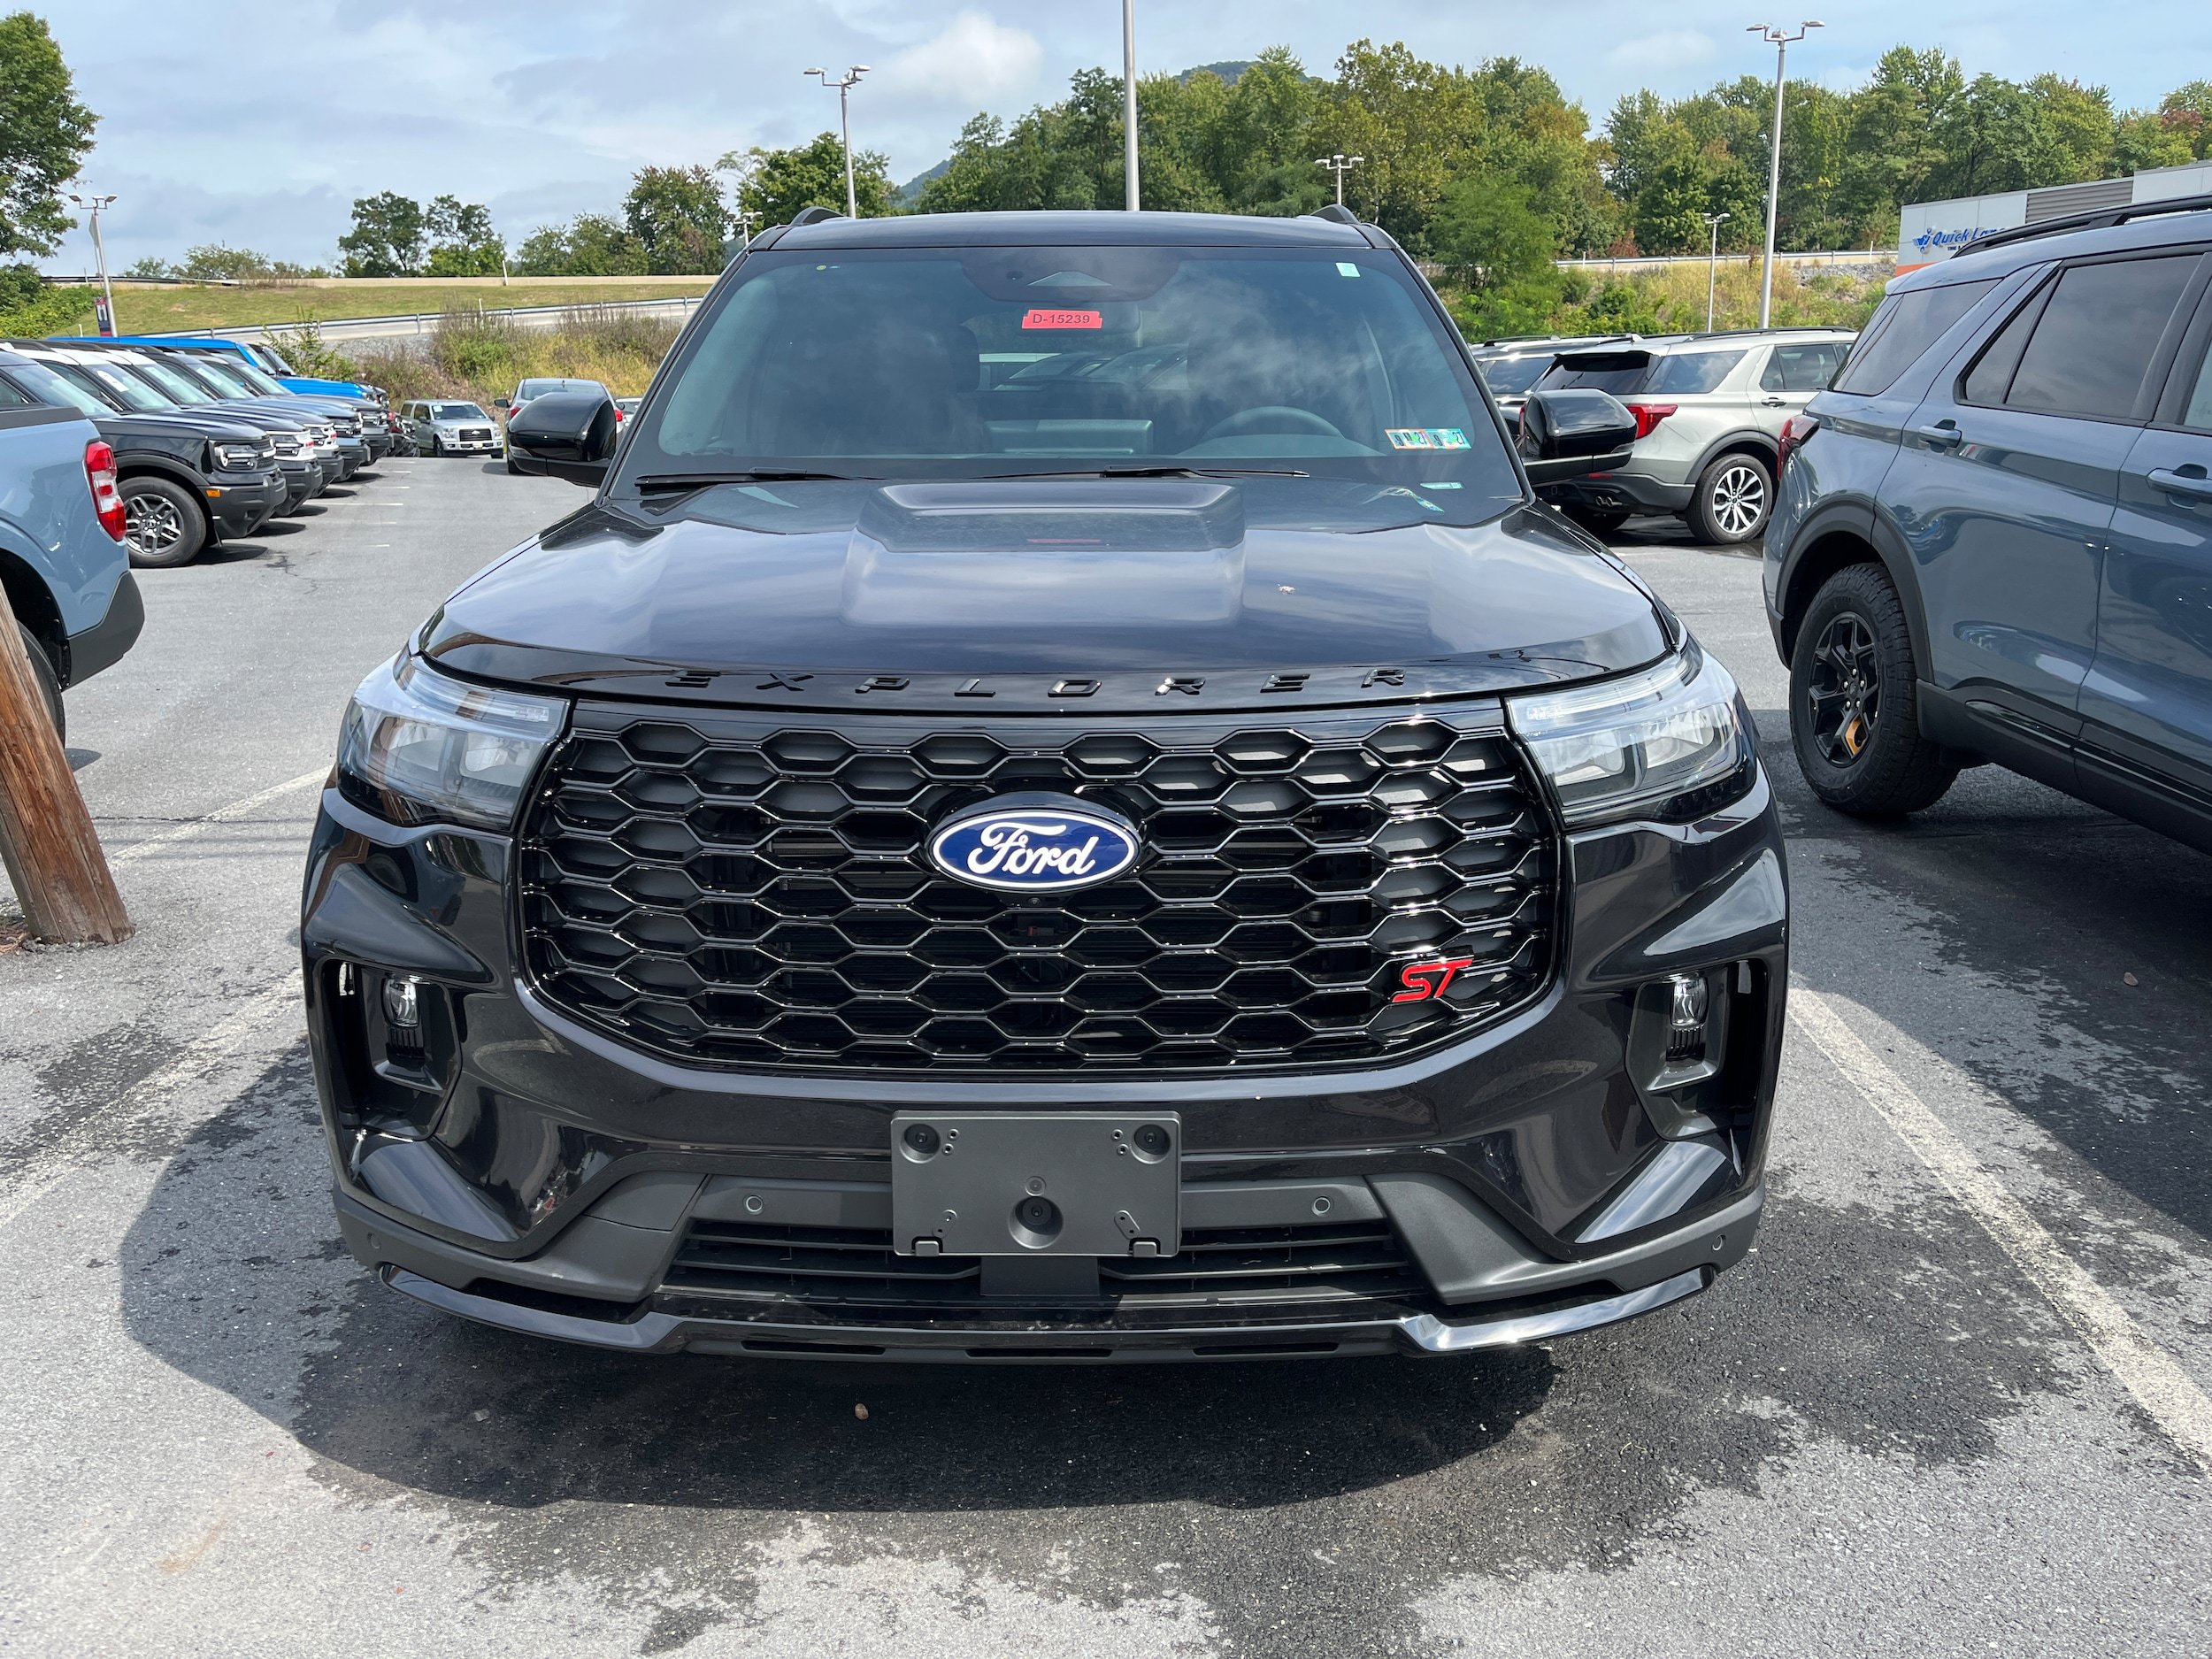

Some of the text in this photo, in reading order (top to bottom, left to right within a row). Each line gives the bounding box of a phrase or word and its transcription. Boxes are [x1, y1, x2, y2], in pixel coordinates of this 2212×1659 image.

[1932, 228, 1970, 246] Quick
[1033, 313, 1090, 324] D-15239
[665, 668, 1408, 698] EXPLORER
[967, 822, 1100, 875] Ford
[1392, 958, 1473, 1002] ST
